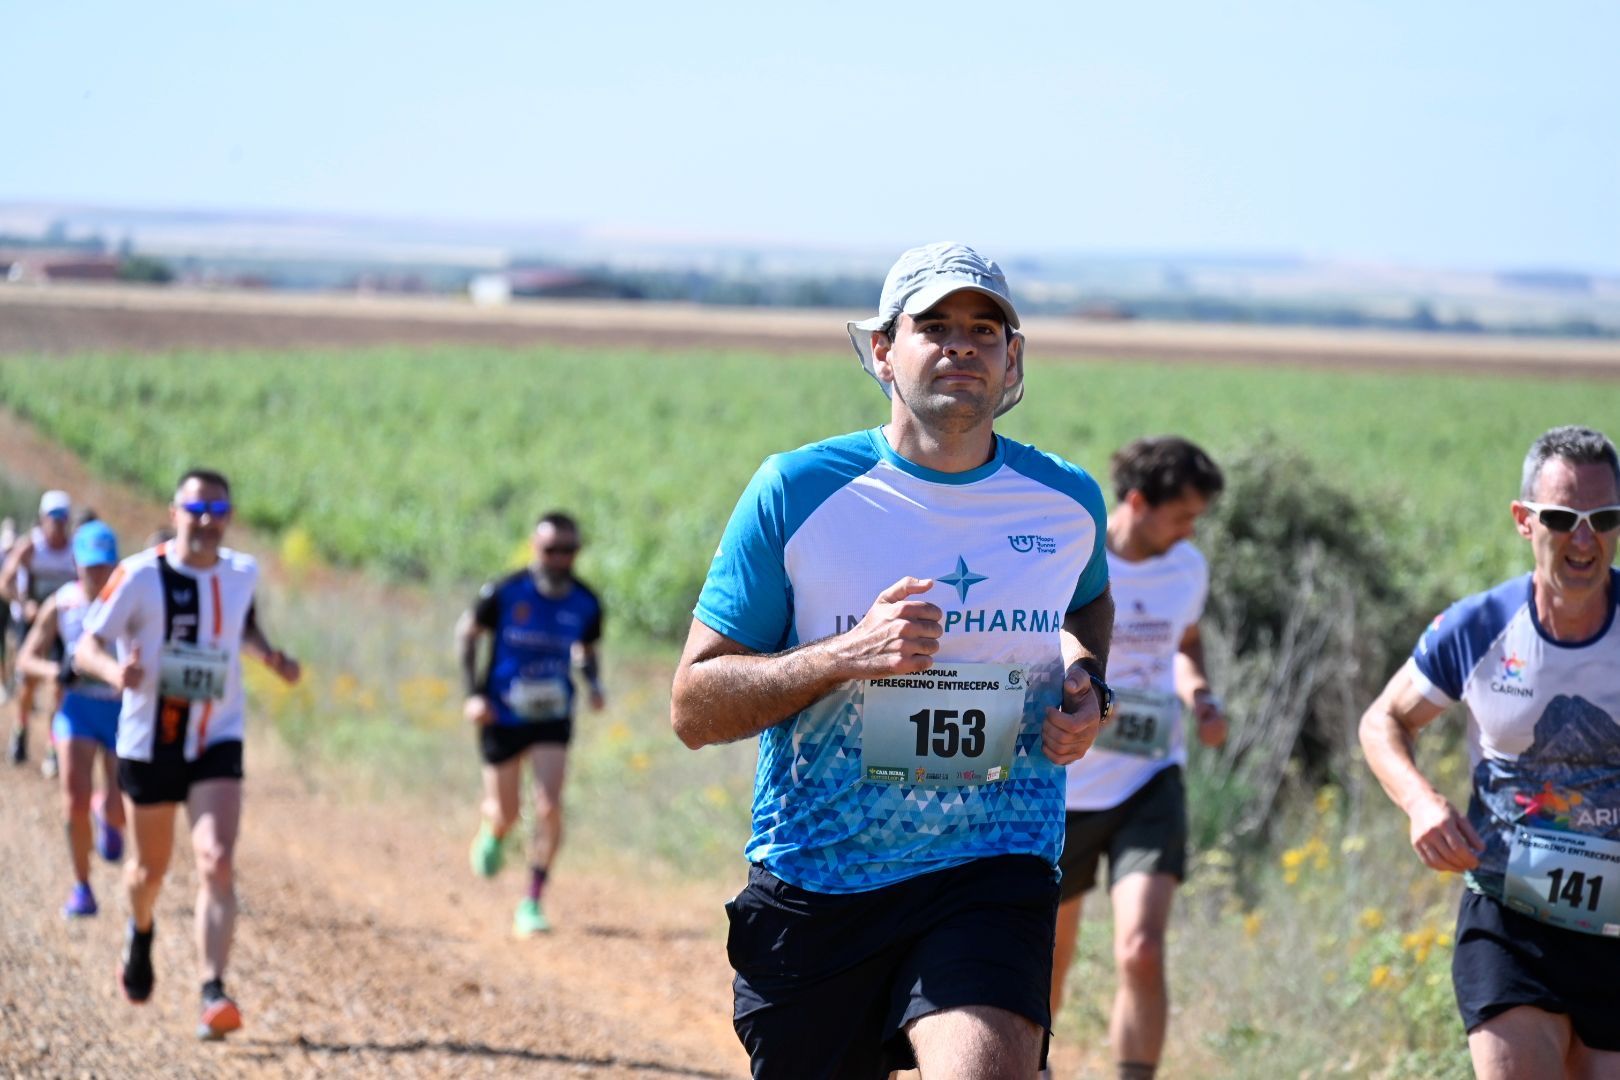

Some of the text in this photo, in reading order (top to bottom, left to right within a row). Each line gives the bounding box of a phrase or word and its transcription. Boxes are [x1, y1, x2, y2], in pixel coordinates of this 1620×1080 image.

[922, 669, 958, 677] POPULAR
[870, 678, 934, 690] PEREGRINO
[937, 680, 1000, 691] ENTRECEPAS
[1491, 682, 1534, 698] CARINN
[909, 709, 986, 758] 153
[1576, 808, 1620, 826] ARI
[1546, 867, 1604, 912] 141
